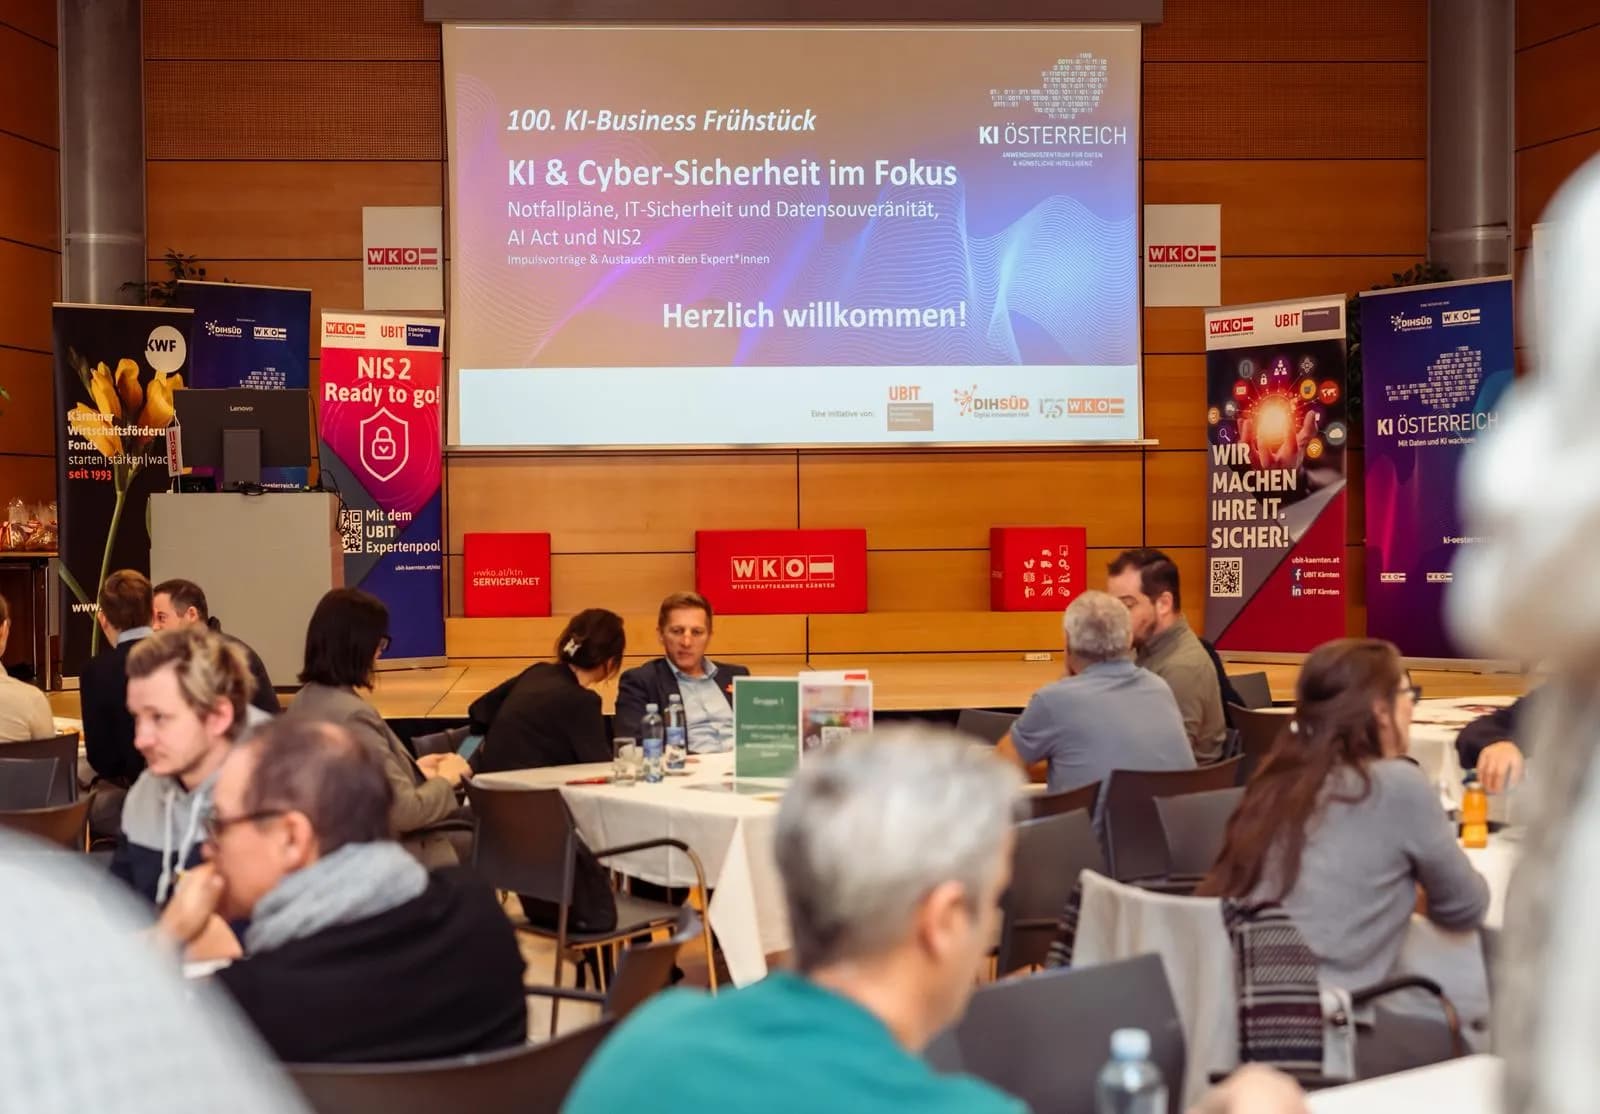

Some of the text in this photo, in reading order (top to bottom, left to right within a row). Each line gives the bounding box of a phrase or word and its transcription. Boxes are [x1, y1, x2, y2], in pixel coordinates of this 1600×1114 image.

[507, 109, 817, 132] 100. KI-Business Frühstück
[979, 122, 1127, 145] KI ÖSTERREICH
[508, 158, 957, 191] KI & Cyber-Sicherheit im Fokus
[508, 200, 940, 221] Notfallpläne, IT-Sicherheit und Datensouveränität,
[508, 229, 642, 246] AI Act und NIS2
[368, 249, 418, 264] WKO
[508, 254, 586, 266] Impulsvorträge
[590, 254, 599, 265] &
[601, 254, 655, 265] Austausch
[658, 254, 676, 265] mit
[678, 254, 697, 265] den
[1149, 247, 1198, 261] WKO
[663, 301, 967, 328] Herzlich willkommen!
[1275, 312, 1301, 328] UBIT
[1401, 315, 1433, 327] DIHSÜD
[1442, 310, 1470, 324] WKO
[254, 328, 278, 336] WKO
[326, 322, 355, 334] WKO
[381, 325, 405, 338] UBIT
[1210, 319, 1242, 334] WKO
[146, 339, 177, 353] KWF
[325, 382, 440, 408] Ready to go!
[888, 385, 921, 401] UBIT
[973, 395, 1030, 410] DIHSÜD
[1068, 399, 1109, 413] WKO
[67, 410, 115, 422] Kärntner
[1377, 412, 1499, 436] KI ÖSTERREICH
[68, 439, 97, 451] Fonds
[1398, 439, 1408, 447] Mit
[1409, 439, 1427, 447] Daten
[1428, 438, 1439, 446] und
[1212, 443, 1251, 466] WIR
[69, 468, 112, 481] seit 1993
[1212, 469, 1297, 493] MACHEN
[366, 508, 412, 521] Mit dem
[1212, 498, 1286, 521] IHRE IT.
[366, 525, 396, 538] UBIT
[1211, 526, 1289, 549] SICHER!
[366, 539, 441, 556] Expertenpool
[732, 558, 806, 579] WKO
[473, 577, 540, 587] SERVICEPAKET
